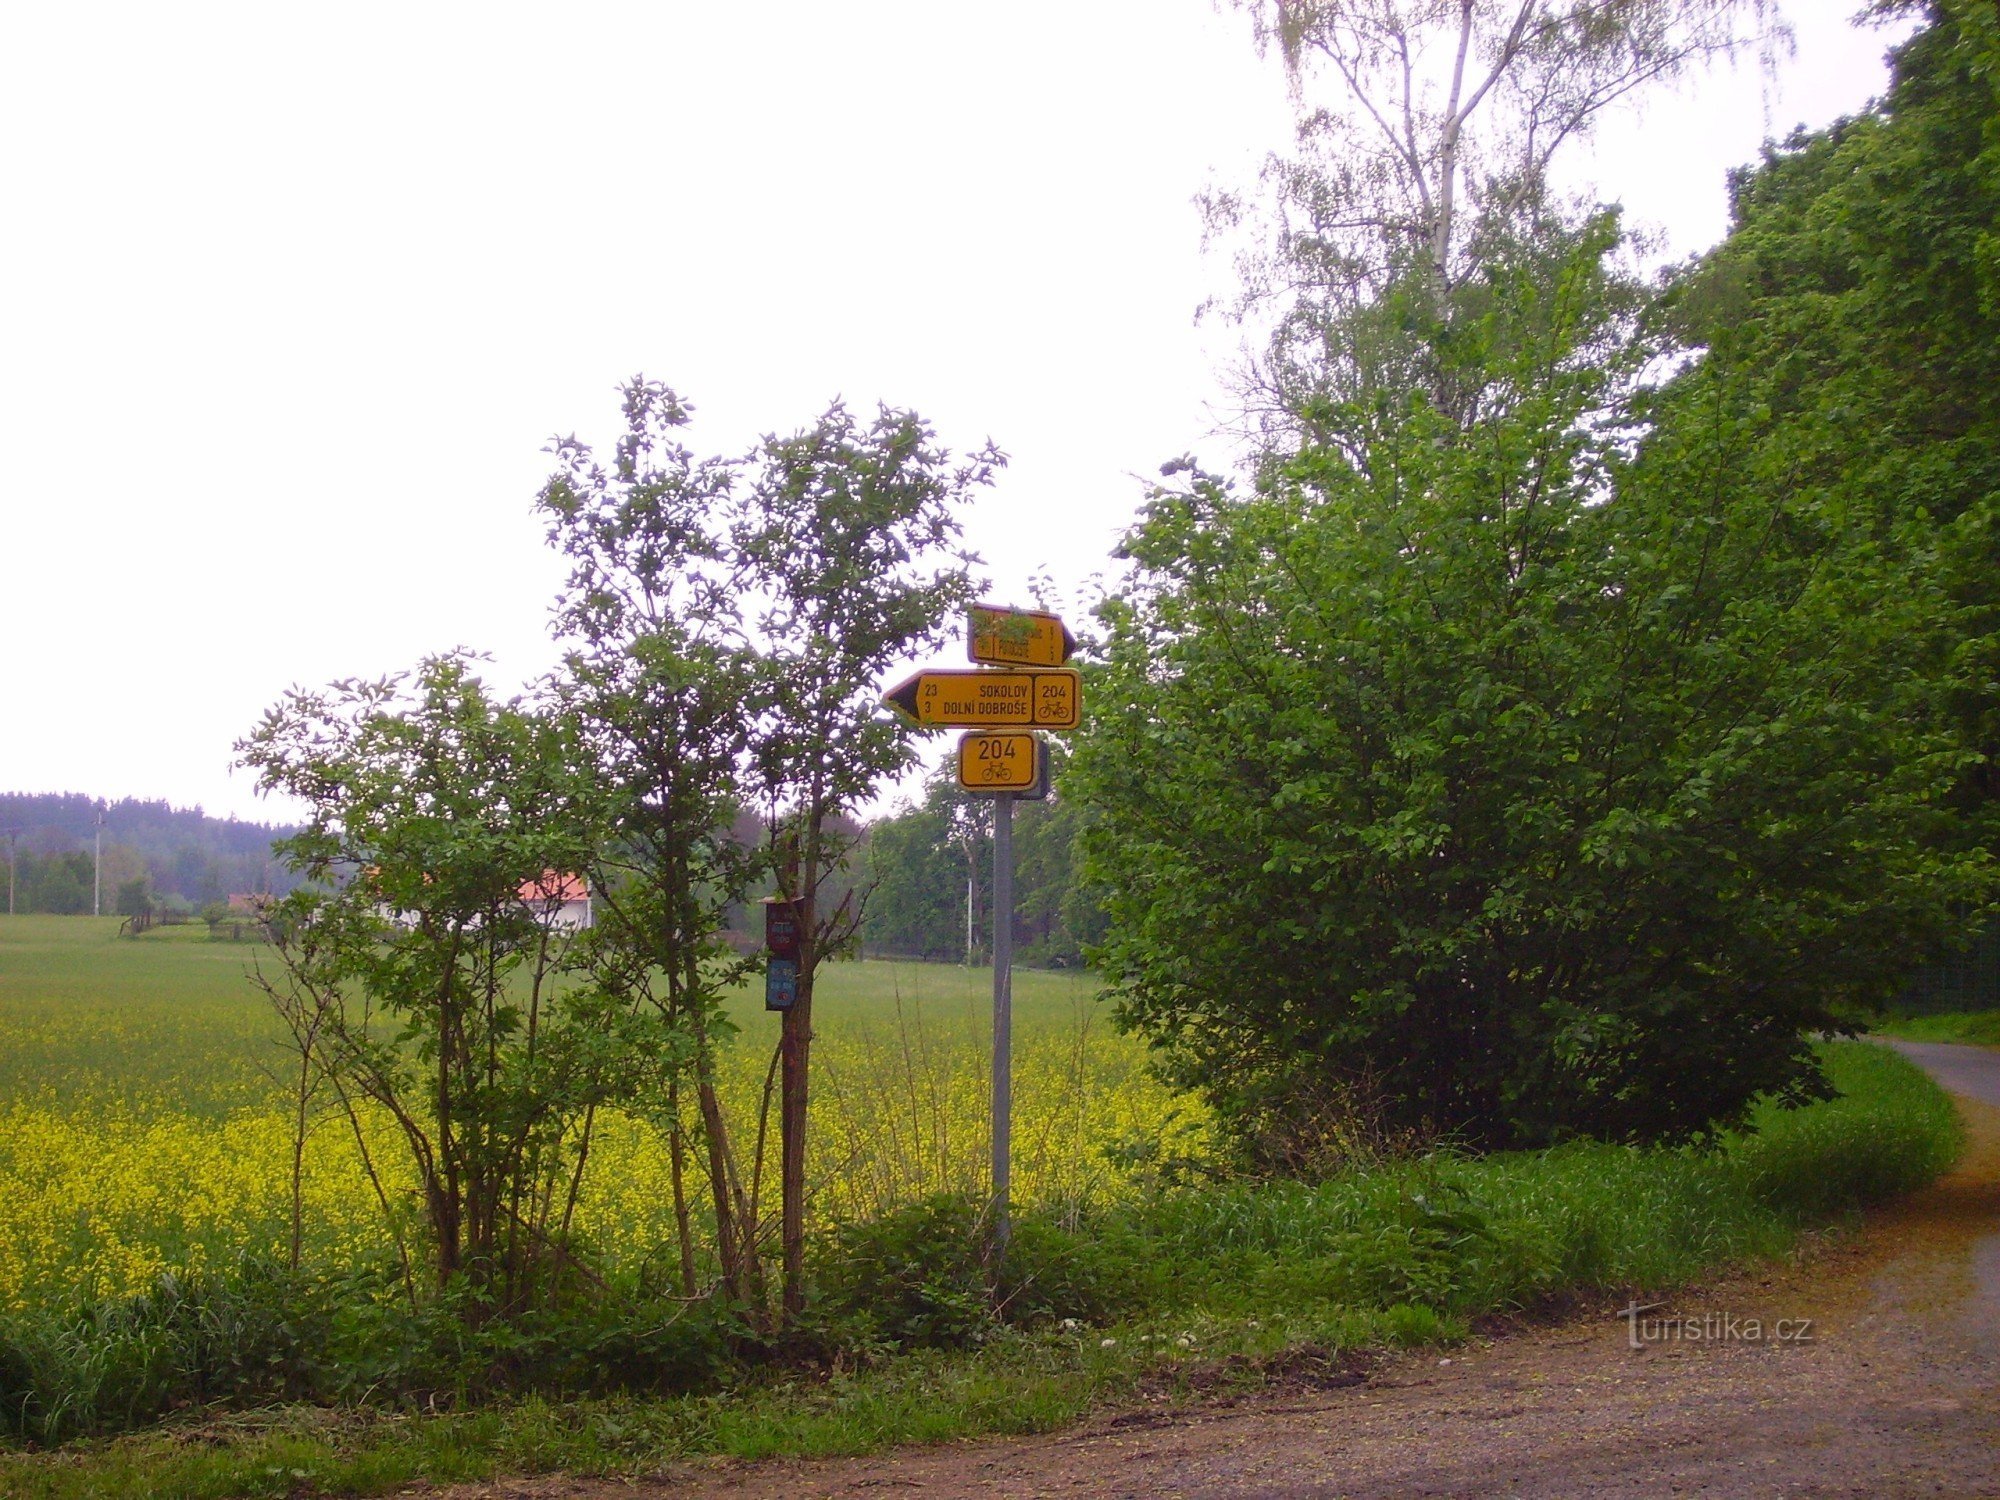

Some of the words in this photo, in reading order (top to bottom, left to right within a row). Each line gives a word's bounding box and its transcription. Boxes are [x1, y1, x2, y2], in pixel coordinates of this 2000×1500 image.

[925, 685, 937, 697] 23
[980, 684, 1027, 697] SOKOLOV
[1042, 685, 1066, 698] 204
[925, 702, 931, 713] 3
[944, 699, 975, 714] DOLNÍ
[979, 700, 1027, 714] DOBROŠE
[978, 739, 1016, 760] 204
